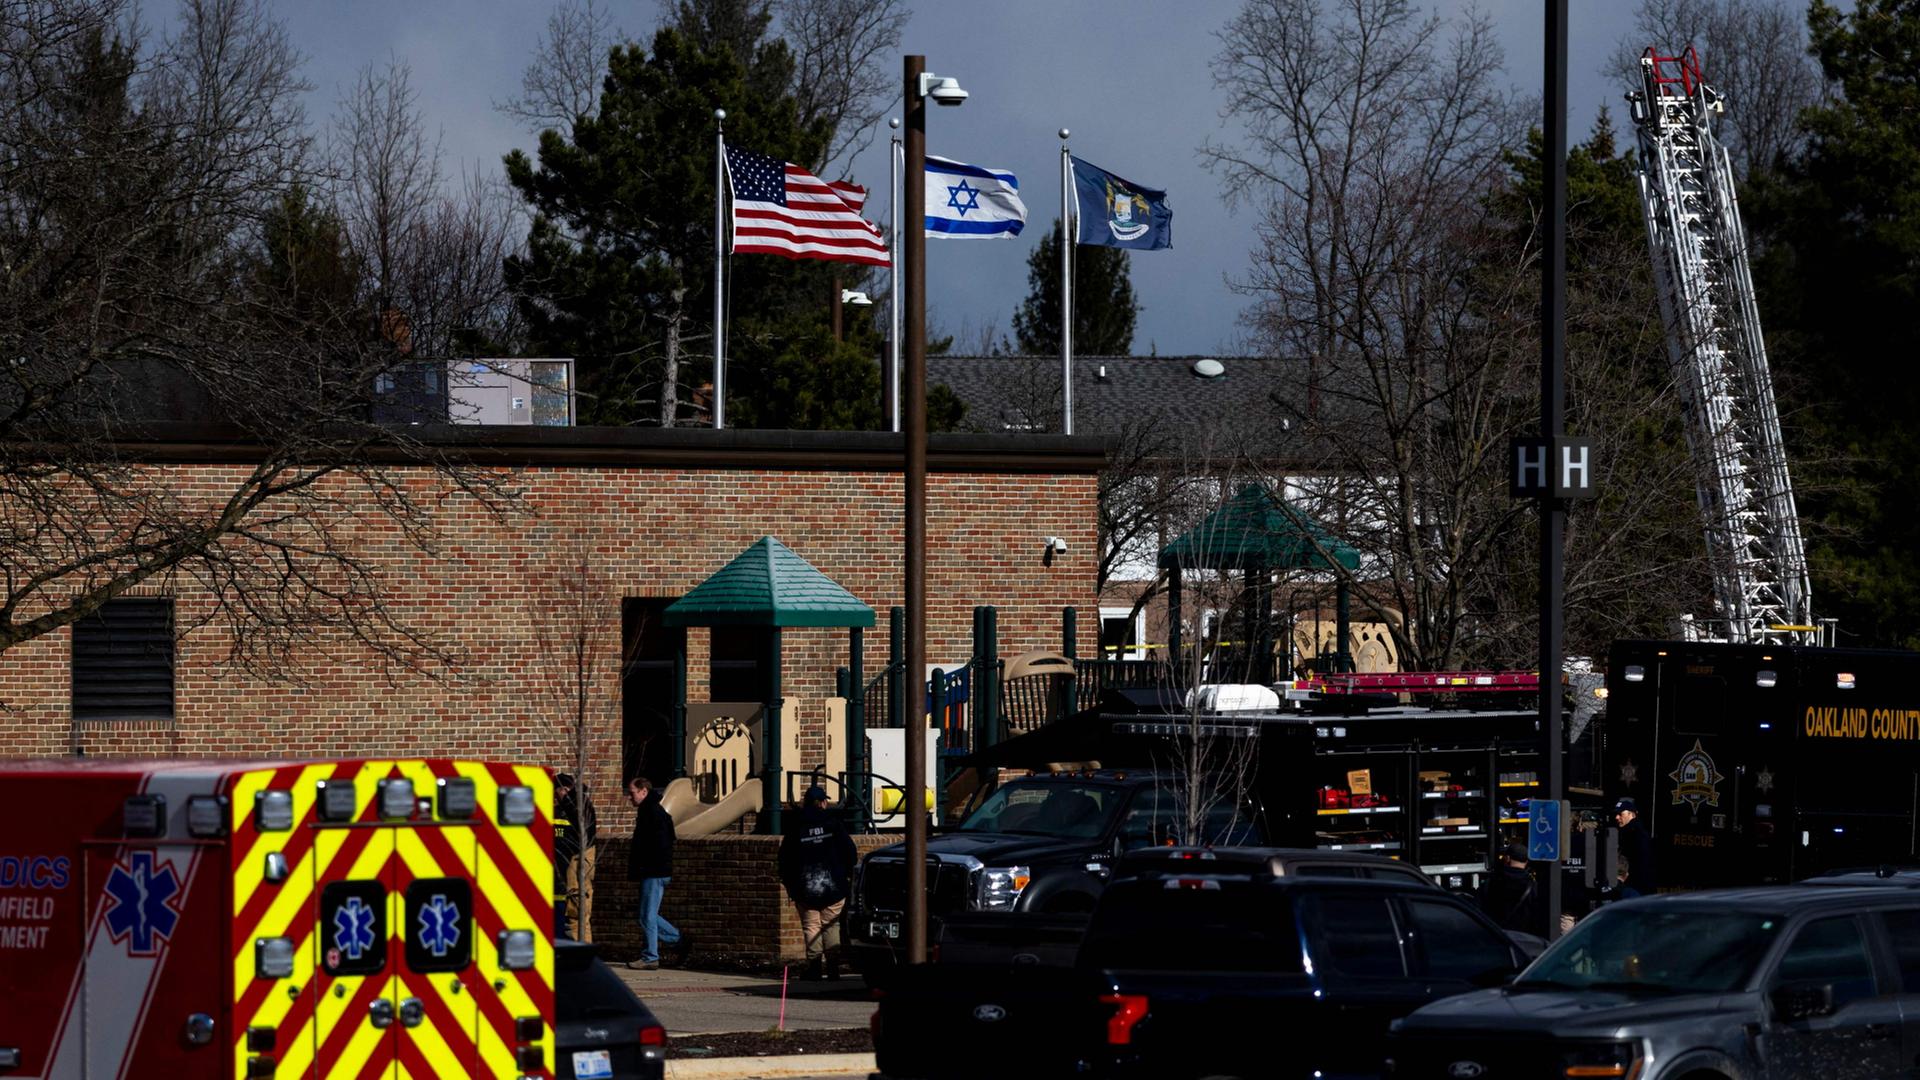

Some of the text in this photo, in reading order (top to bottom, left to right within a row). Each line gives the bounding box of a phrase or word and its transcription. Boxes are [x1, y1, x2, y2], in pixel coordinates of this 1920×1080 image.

[1517, 446, 1547, 488] H
[1562, 446, 1589, 488] H
[1805, 706, 1868, 738] OAKLAND
[808, 827, 824, 836] FBI
[1673, 833, 1715, 848] RESCUE
[0, 855, 71, 889] DICS
[1566, 857, 1582, 865] FBI
[0, 925, 50, 950] MENT
